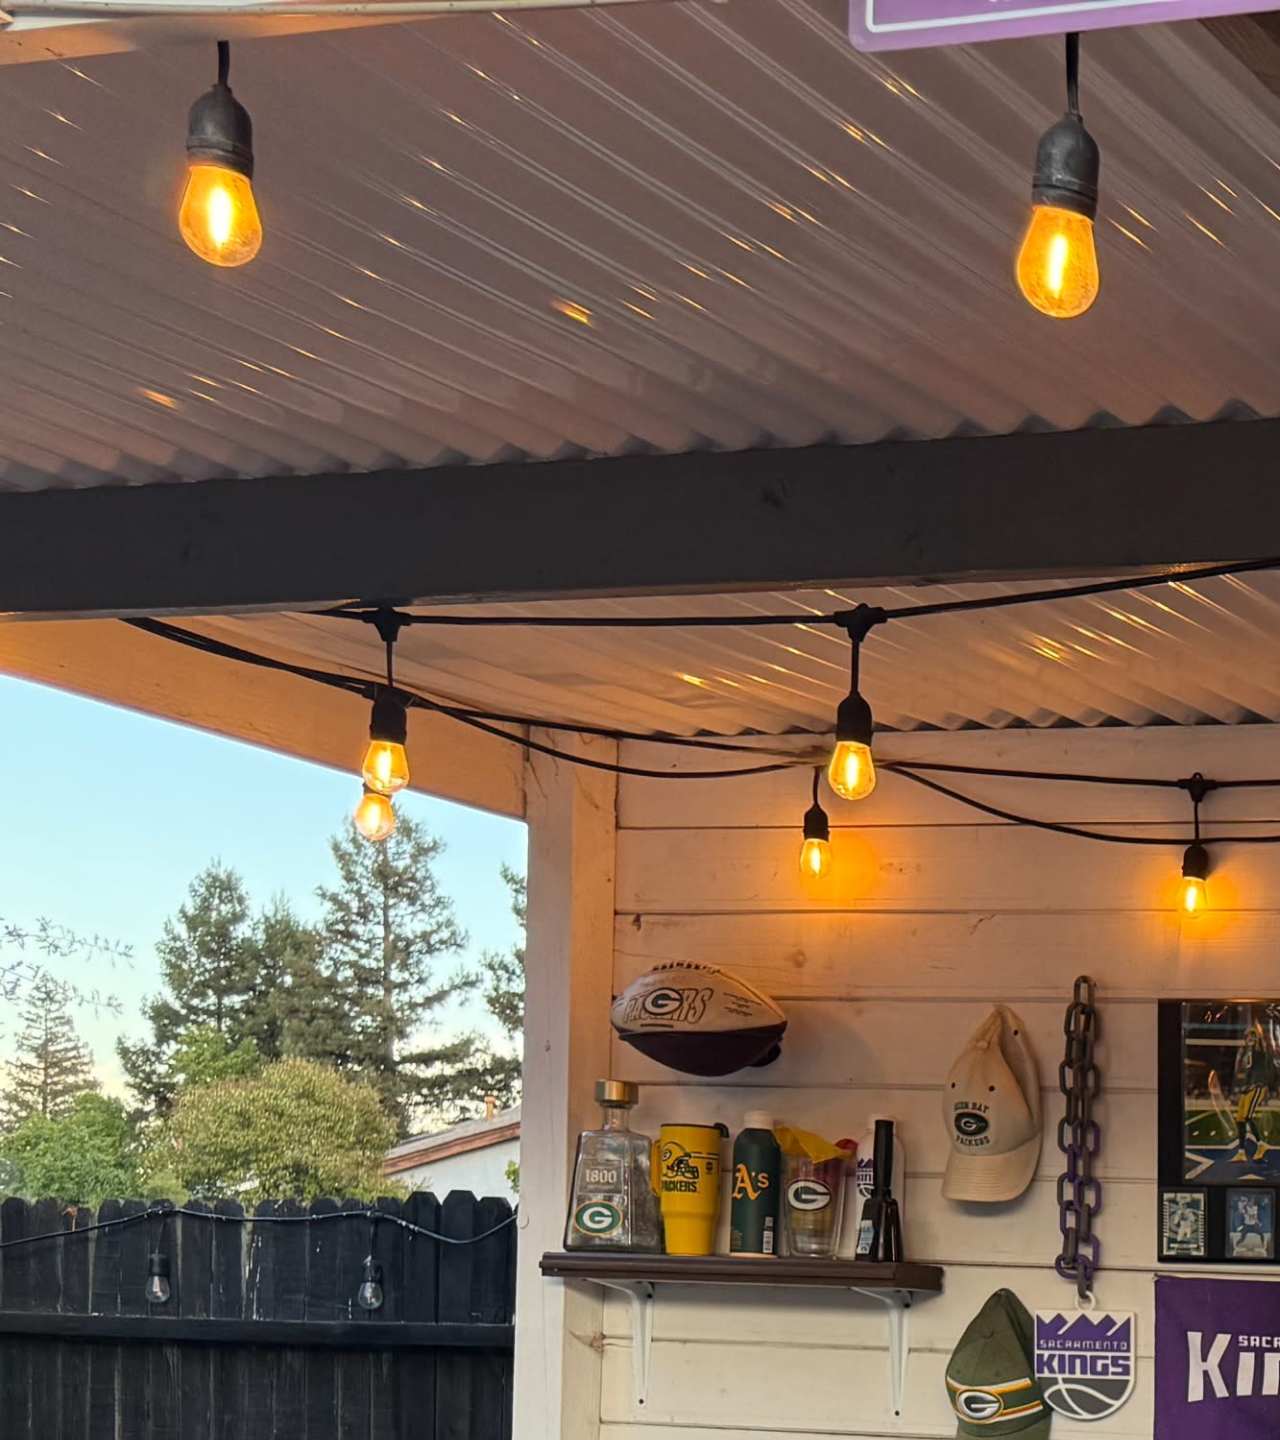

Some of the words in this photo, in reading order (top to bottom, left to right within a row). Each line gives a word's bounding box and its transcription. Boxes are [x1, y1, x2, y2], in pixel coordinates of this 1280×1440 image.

[585, 1169, 617, 1184] 1800
[732, 1163, 770, 1200] A's
[1039, 1339, 1128, 1350] SACRAMENTO
[1036, 1353, 1131, 1377] KINGS
